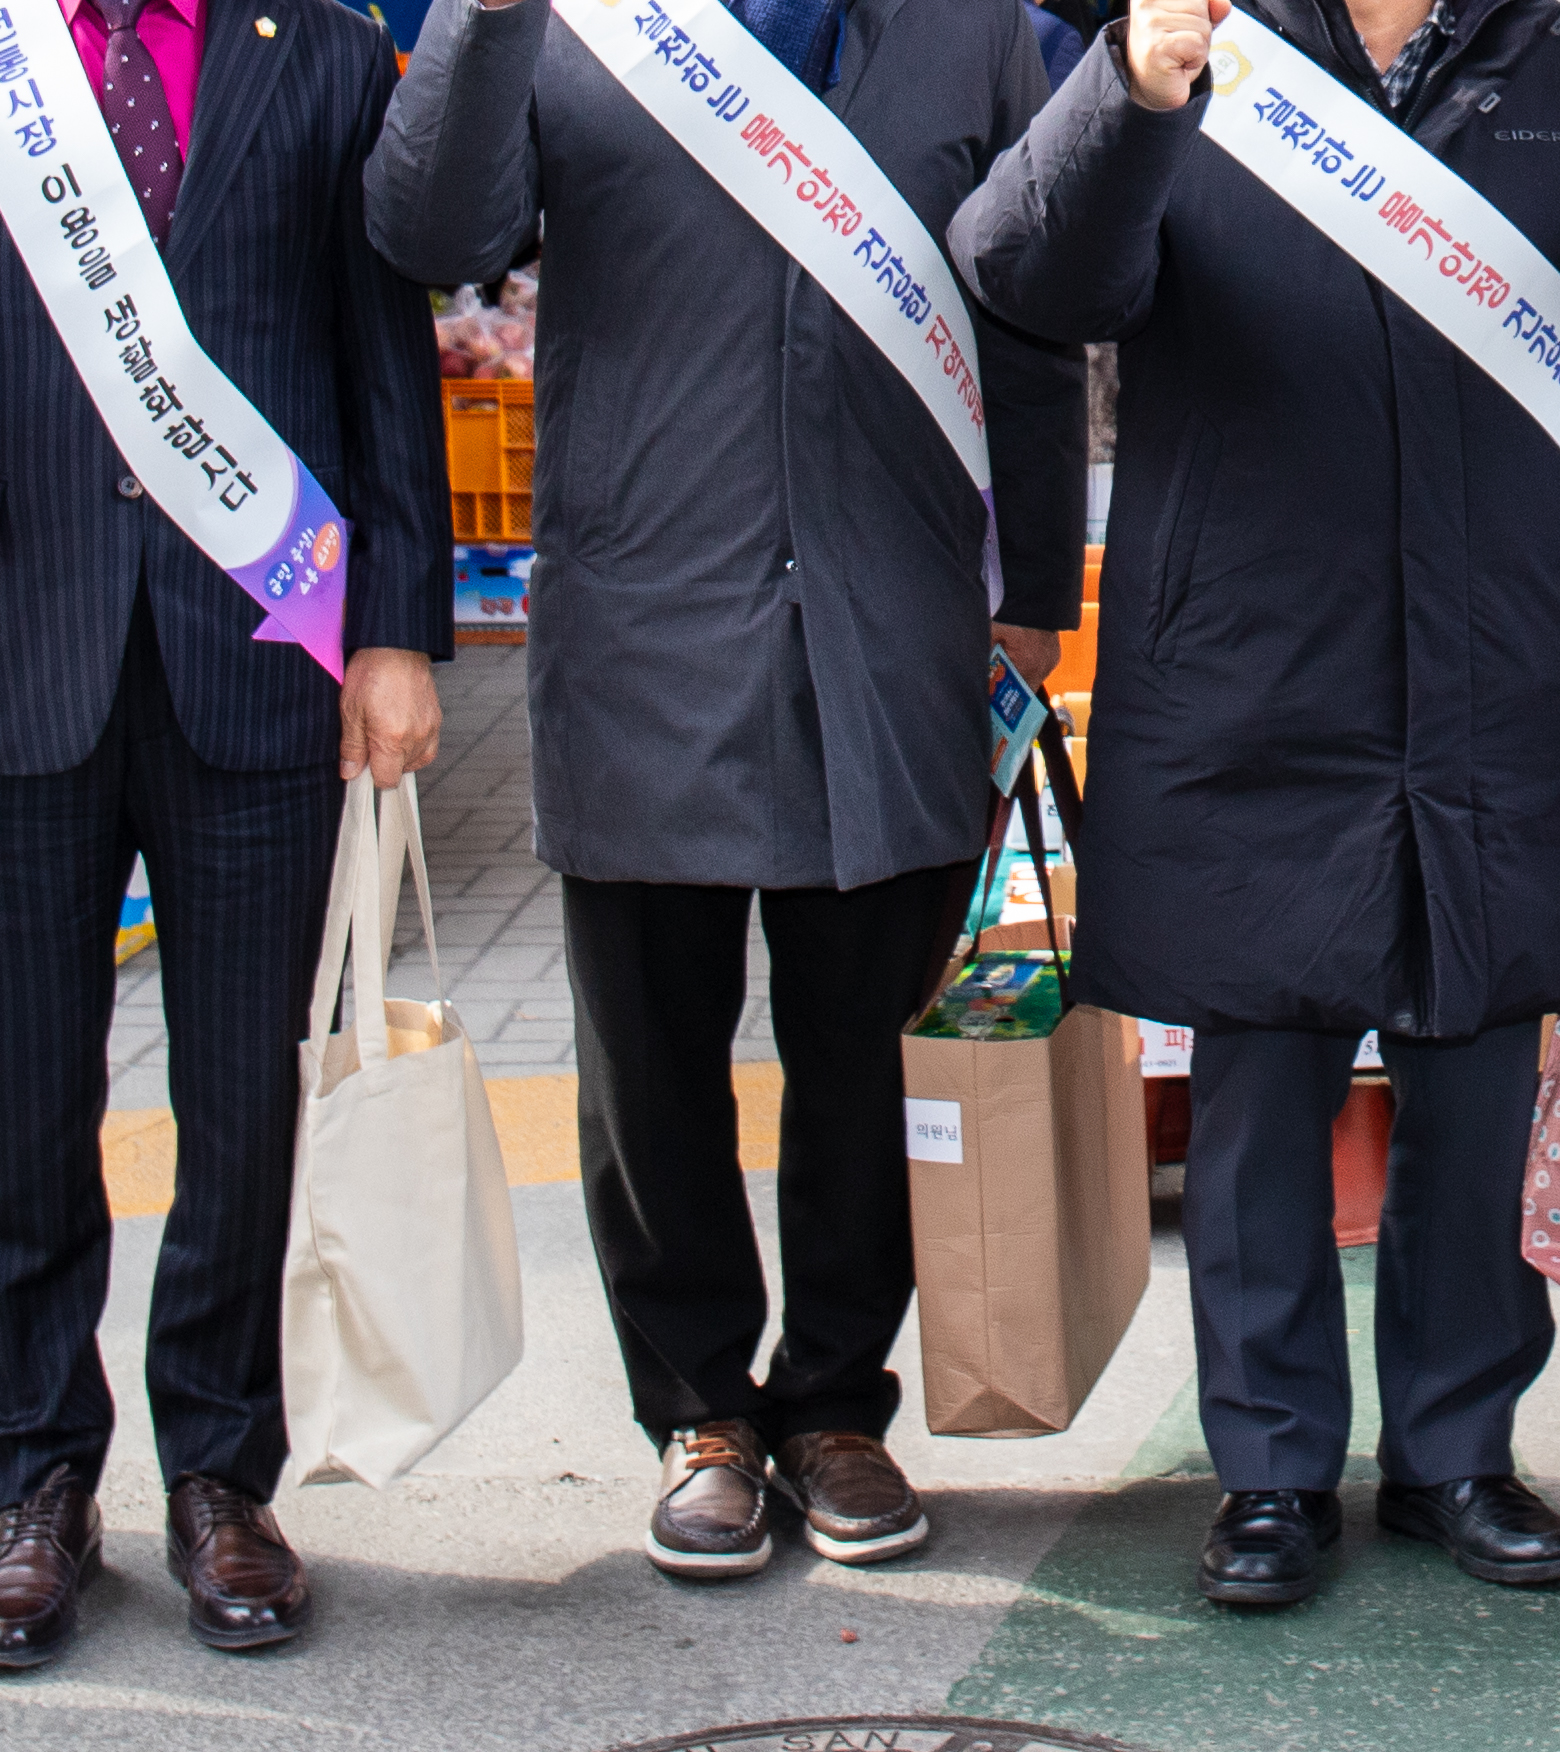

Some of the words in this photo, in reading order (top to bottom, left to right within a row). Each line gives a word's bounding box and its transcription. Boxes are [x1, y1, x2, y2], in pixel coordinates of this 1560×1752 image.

[634, 0, 750, 123] 실천하는
[740, 112, 864, 237] 물가안정
[853, 228, 933, 327] 건강한
[1252, 87, 1386, 202] 실천하는
[1378, 190, 1513, 310] 물가안정
[41, 163, 117, 291] 이용을
[103, 292, 260, 514] 생활화합시다
[915, 1122, 958, 1142] 의원님
